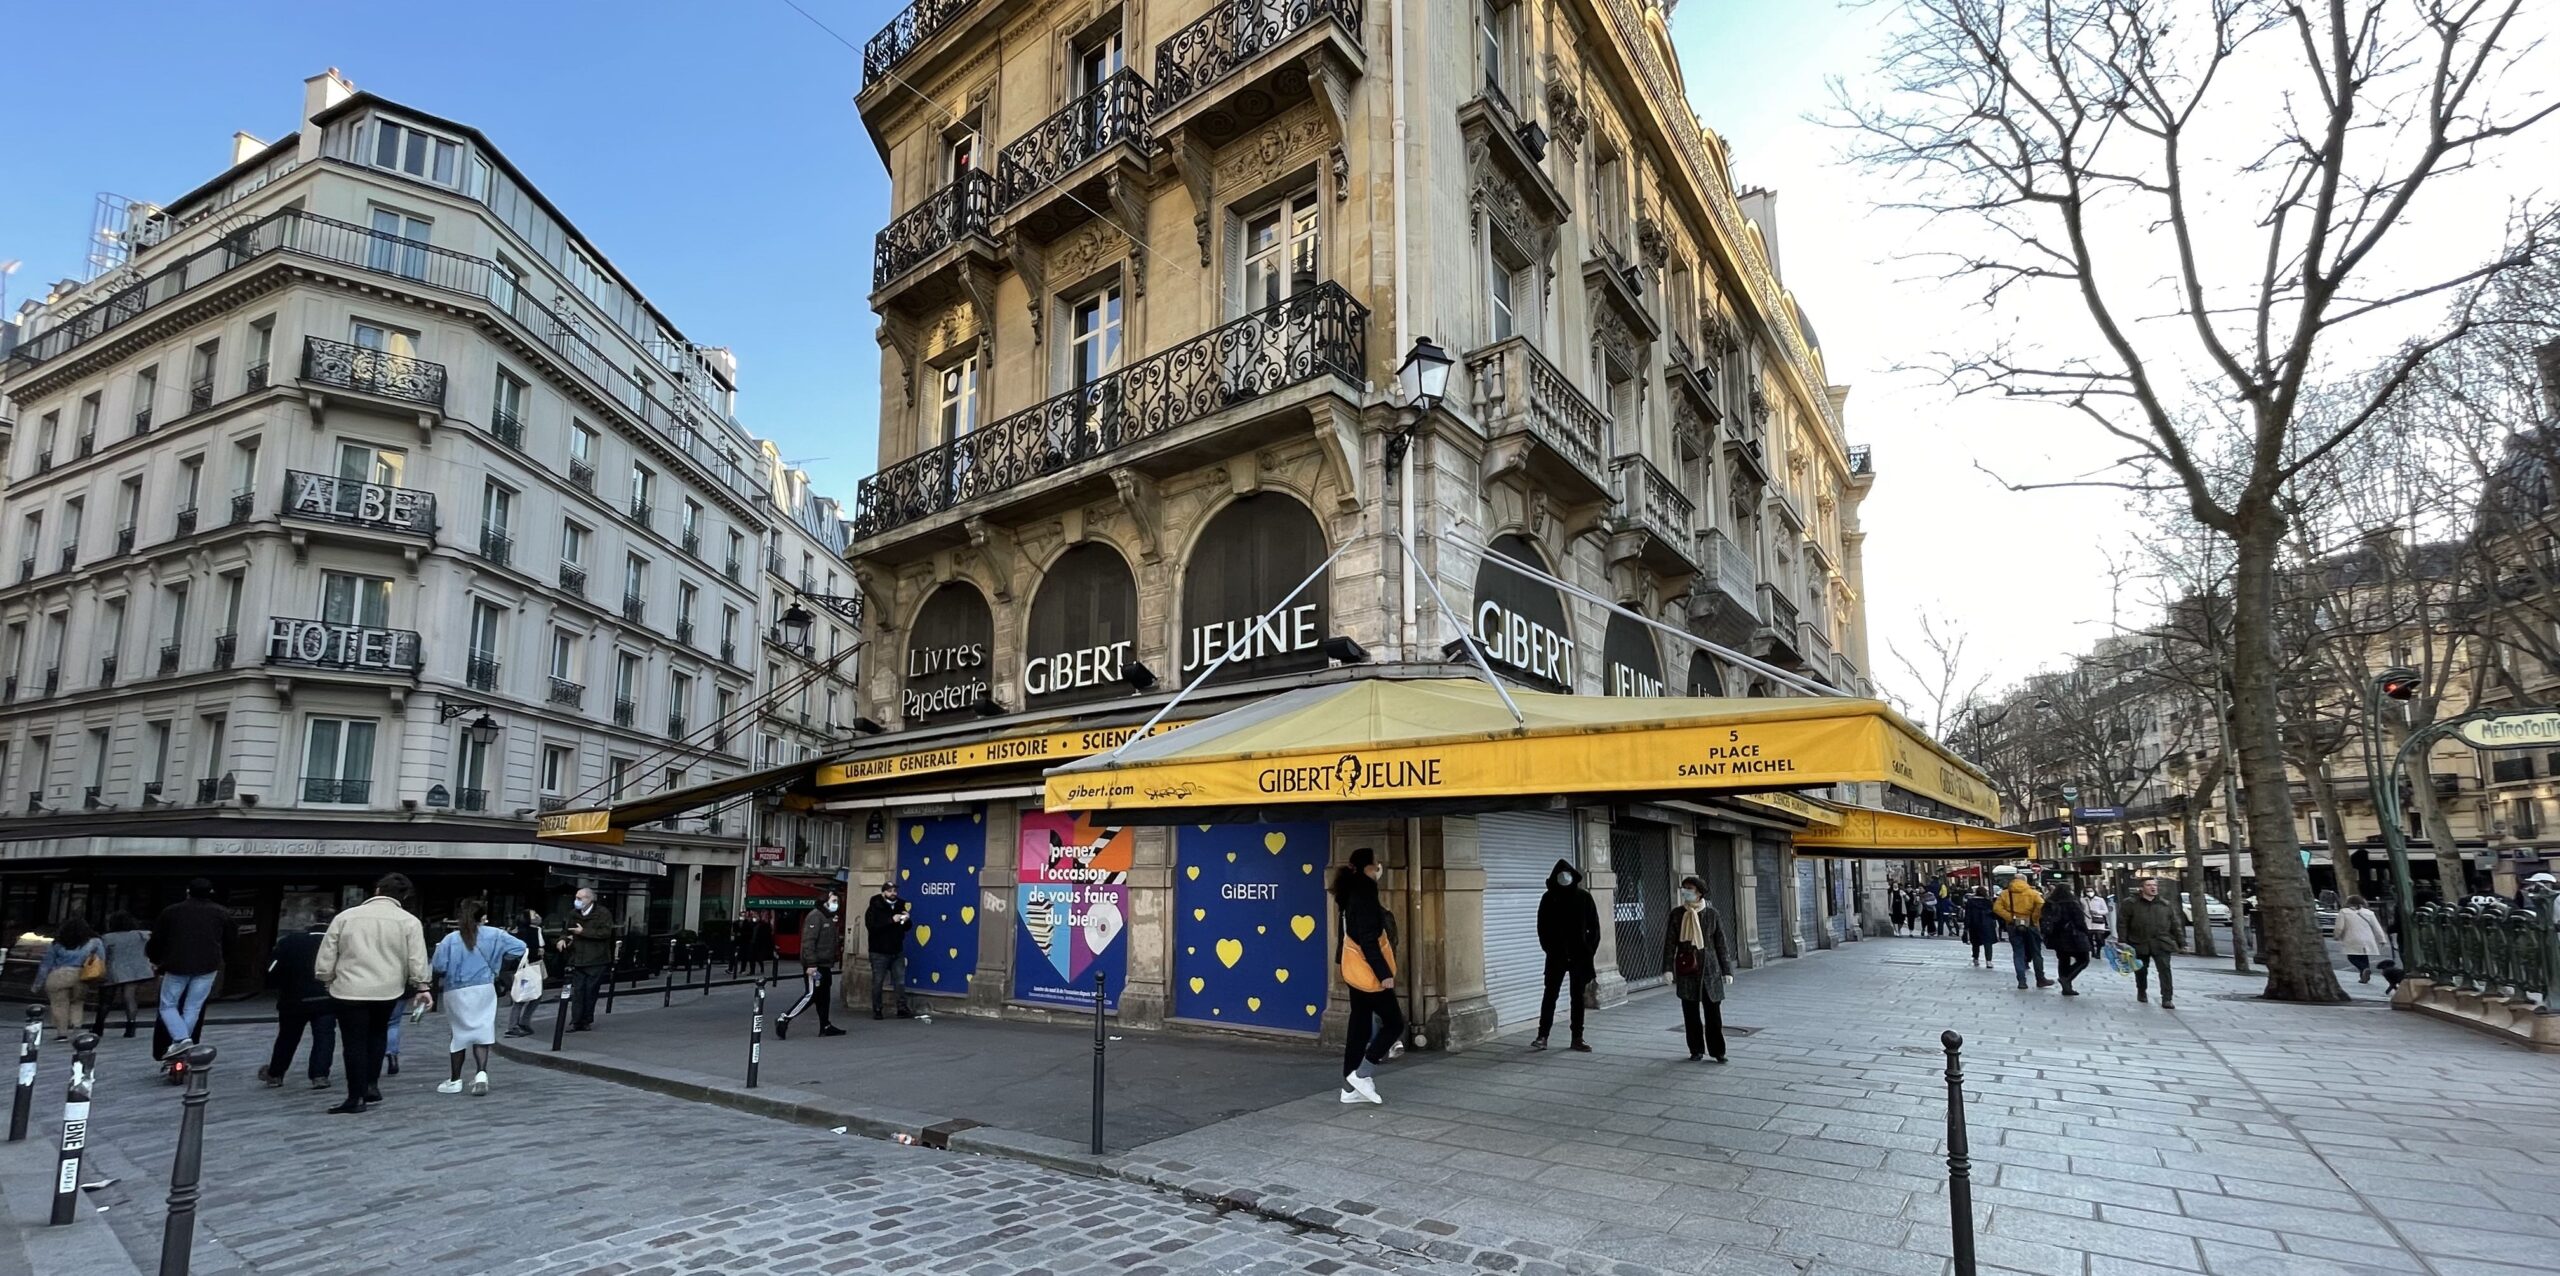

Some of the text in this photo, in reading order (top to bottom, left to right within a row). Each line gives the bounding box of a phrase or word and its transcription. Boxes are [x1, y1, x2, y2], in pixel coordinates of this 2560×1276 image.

[295, 474, 414, 527] ALBE
[265, 618, 413, 670] HOTEL
[1183, 603, 1320, 673] JEUNE
[1478, 600, 1575, 688] GIBERT
[909, 643, 982, 677] Livres
[1024, 640, 1131, 695] GIBERT
[901, 676, 987, 722] Papeterie
[1729, 730, 1739, 742] 5
[987, 738, 1048, 761] HISTOIRE
[1709, 745, 1760, 759] PLACE
[845, 750, 958, 779] LIBRAIRIE GENERALE
[1258, 758, 1443, 794] GIBERT JEUNE
[1678, 759, 1796, 776] SAINT MICHEL
[1067, 784, 1135, 801] gibert.com
[214, 842, 431, 856] BOULANGERIE SAINT MICHEL
[1051, 846, 1097, 863] prenez
[1040, 863, 1108, 880] l'occasion
[1029, 885, 1119, 904] de vous faire
[1221, 883, 1279, 900] GiBERT
[1045, 907, 1098, 927] du bien
[65, 1119, 85, 1150] BNE
